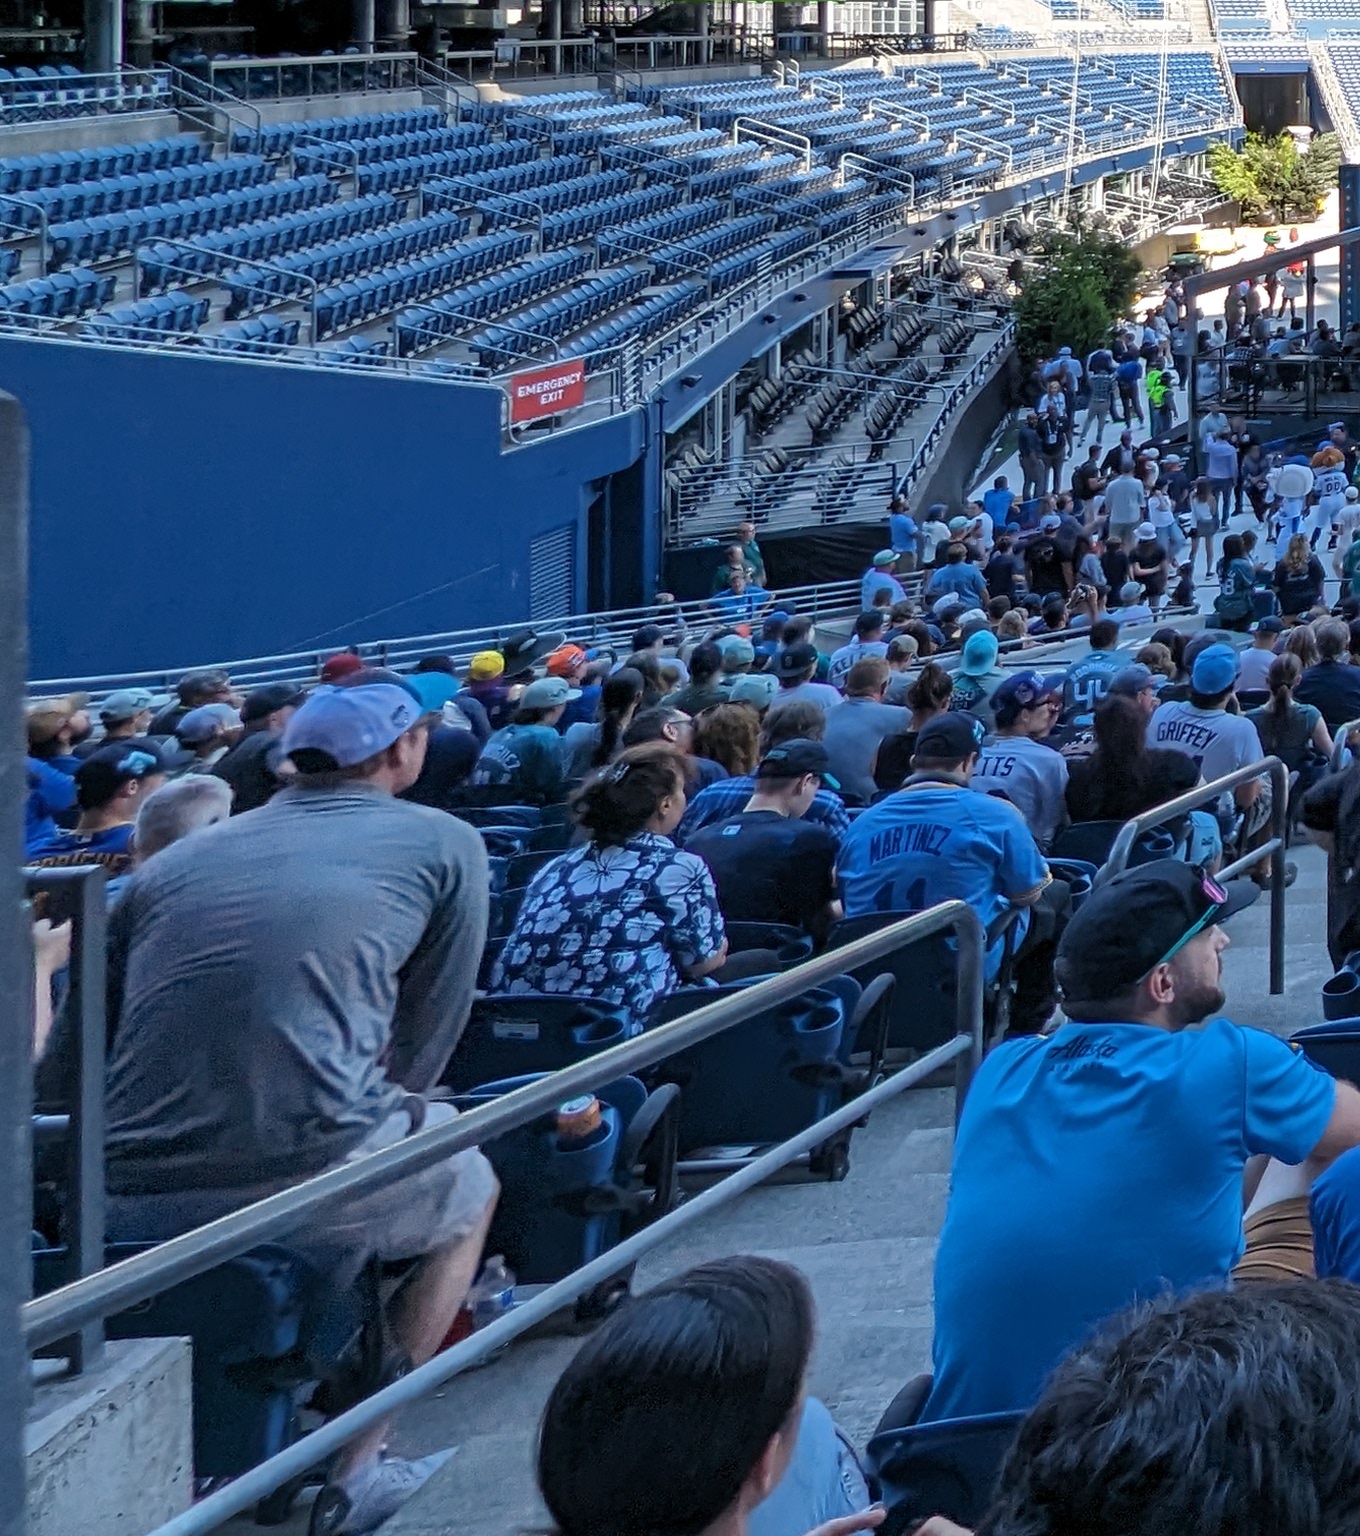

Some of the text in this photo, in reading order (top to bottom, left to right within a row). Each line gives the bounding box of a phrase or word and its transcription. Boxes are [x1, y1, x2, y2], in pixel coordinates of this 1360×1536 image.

[517, 371, 583, 398] EMERGENCY
[540, 389, 565, 405] EXIT
[1326, 481, 1343, 494] 00
[1155, 721, 1218, 751] GRIFFEY
[869, 822, 953, 864] MARTINEZ
[1049, 1034, 1119, 1060] Alaska
